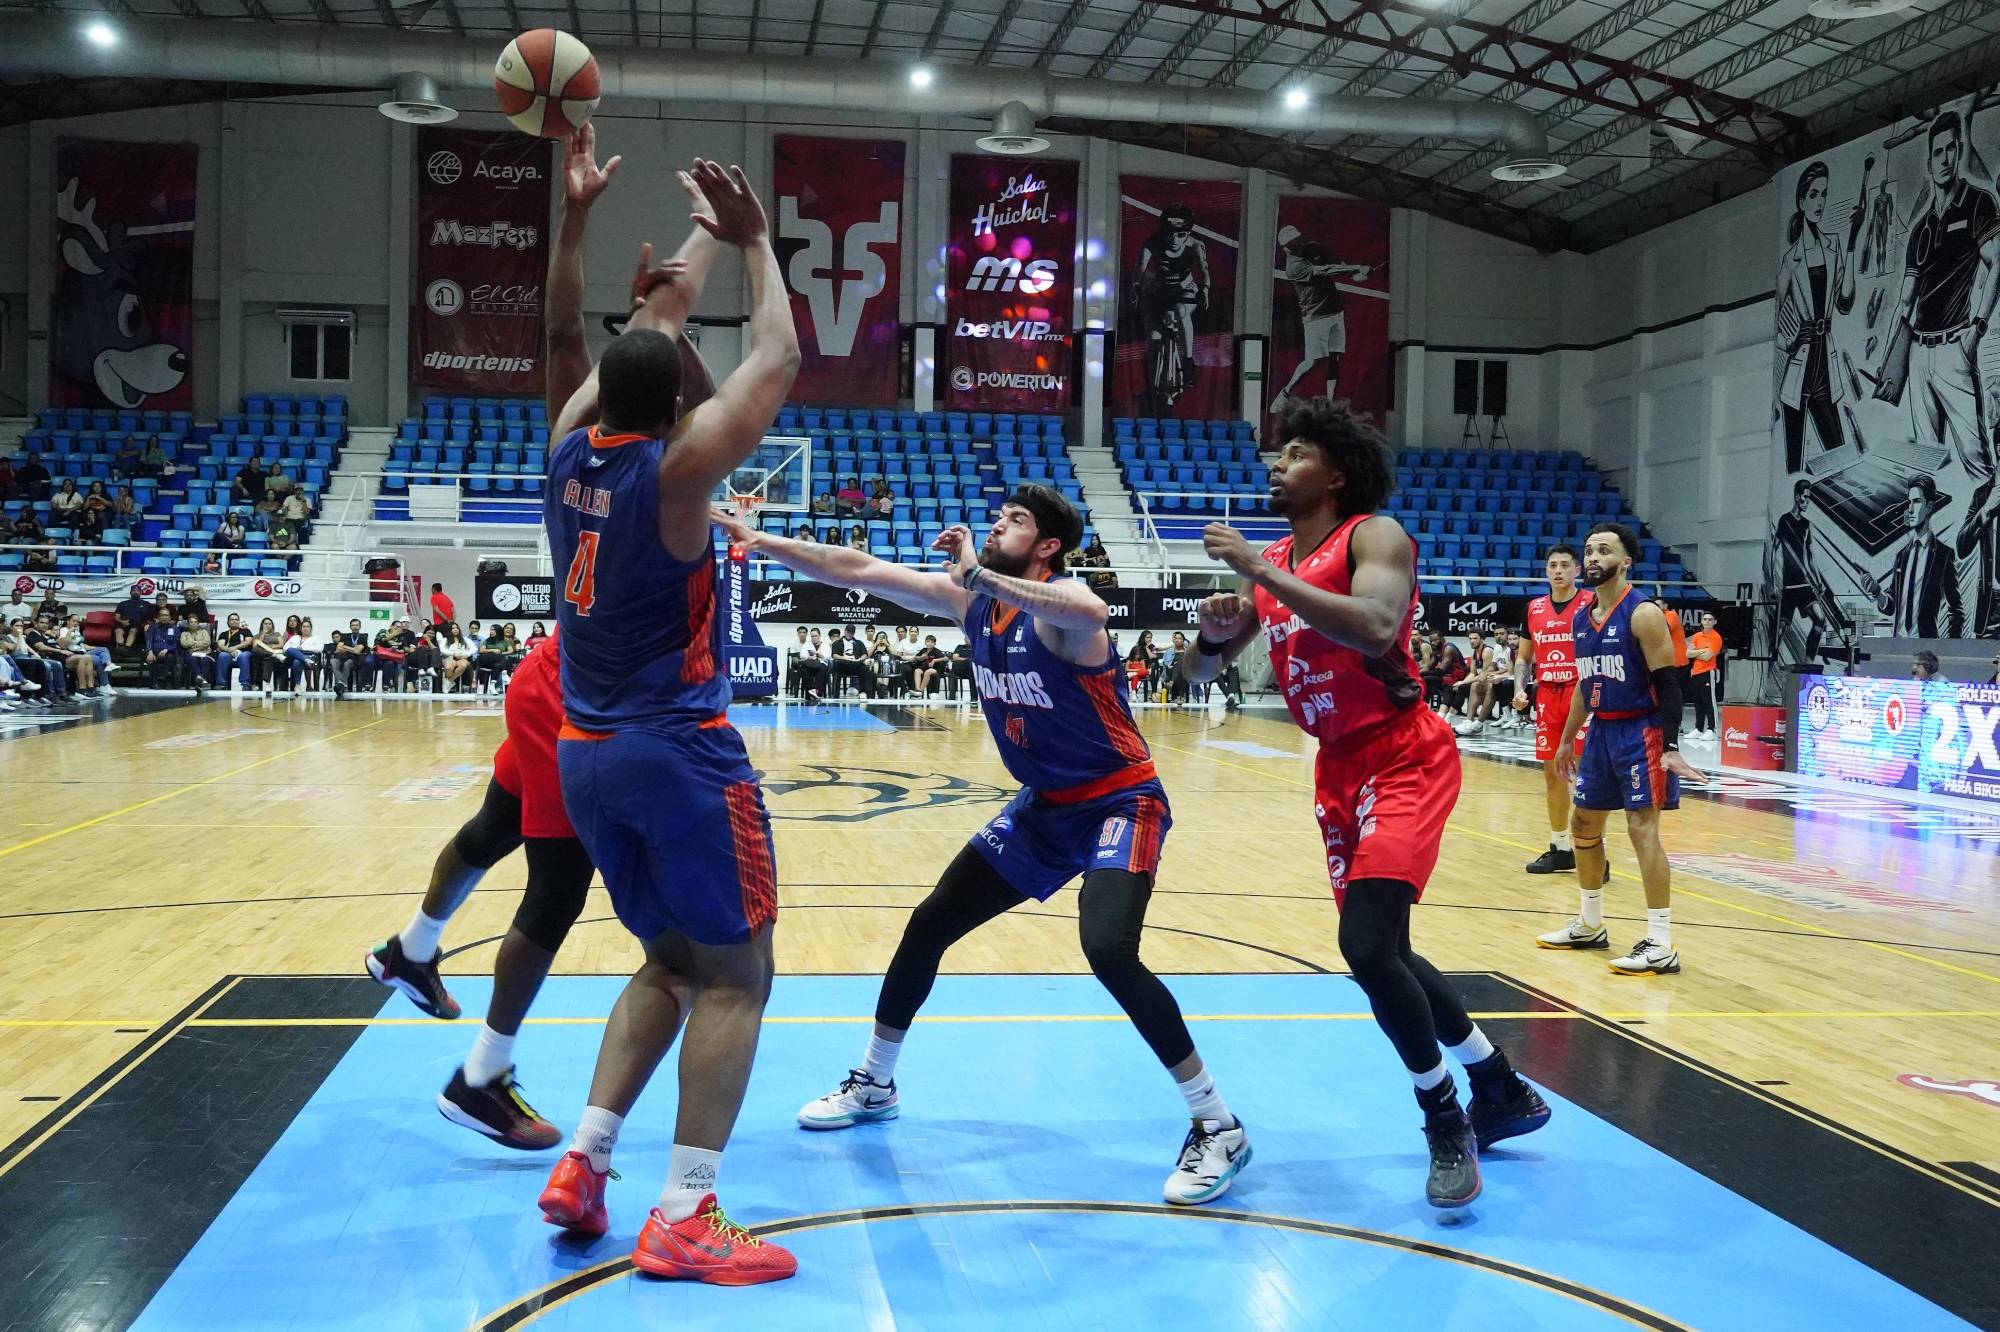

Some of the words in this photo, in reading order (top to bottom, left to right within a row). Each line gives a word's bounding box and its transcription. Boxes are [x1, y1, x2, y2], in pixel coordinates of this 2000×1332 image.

[997, 173, 1047, 203] Salsa
[971, 192, 1049, 237] Huichol
[430, 219, 538, 251] MazFest
[470, 284, 502, 301] El
[954, 317, 1065, 342] betVIP.mx
[423, 351, 535, 372] dportenis
[563, 478, 612, 518] ALLEN
[565, 530, 600, 617] 4
[36, 578, 65, 591] CID
[156, 579, 185, 592] UAD
[273, 583, 301, 594] CID
[521, 584, 551, 594] COLEGIO
[763, 583, 792, 601] Salsa
[729, 562, 744, 644] dportenis
[748, 593, 793, 619] Huichol
[851, 606, 882, 614] ACUARIO
[1449, 601, 1498, 615] KIA
[1448, 618, 1497, 632] Pacific
[730, 656, 773, 677] UAD
[1553, 671, 1573, 680] UAD
[1590, 682, 1602, 708] 5
[1631, 764, 1640, 789] 5
[1099, 816, 1128, 847] 87
